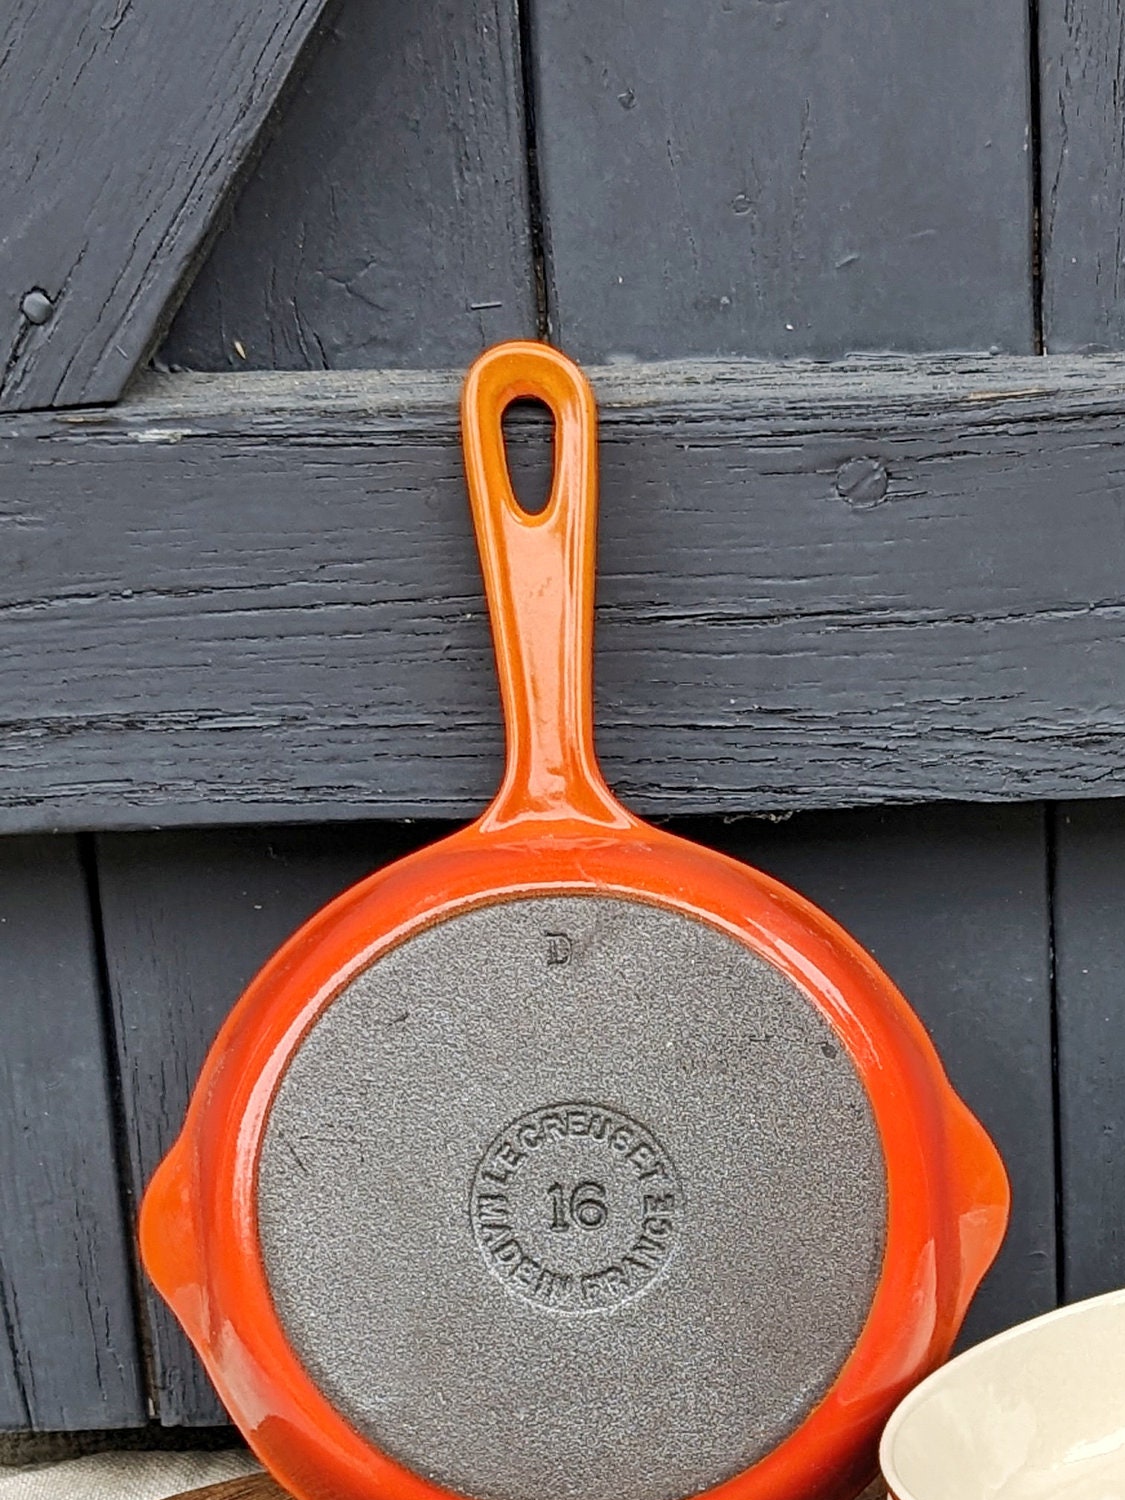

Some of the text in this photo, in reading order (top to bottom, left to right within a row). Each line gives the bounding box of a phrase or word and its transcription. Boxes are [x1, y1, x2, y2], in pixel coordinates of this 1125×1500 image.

[543, 931, 574, 967] D
[480, 1110, 671, 1184] LE CREUSET
[547, 1181, 608, 1232] 16
[477, 1194, 541, 1284] MADE
[579, 1194, 676, 1300] FRANCE
